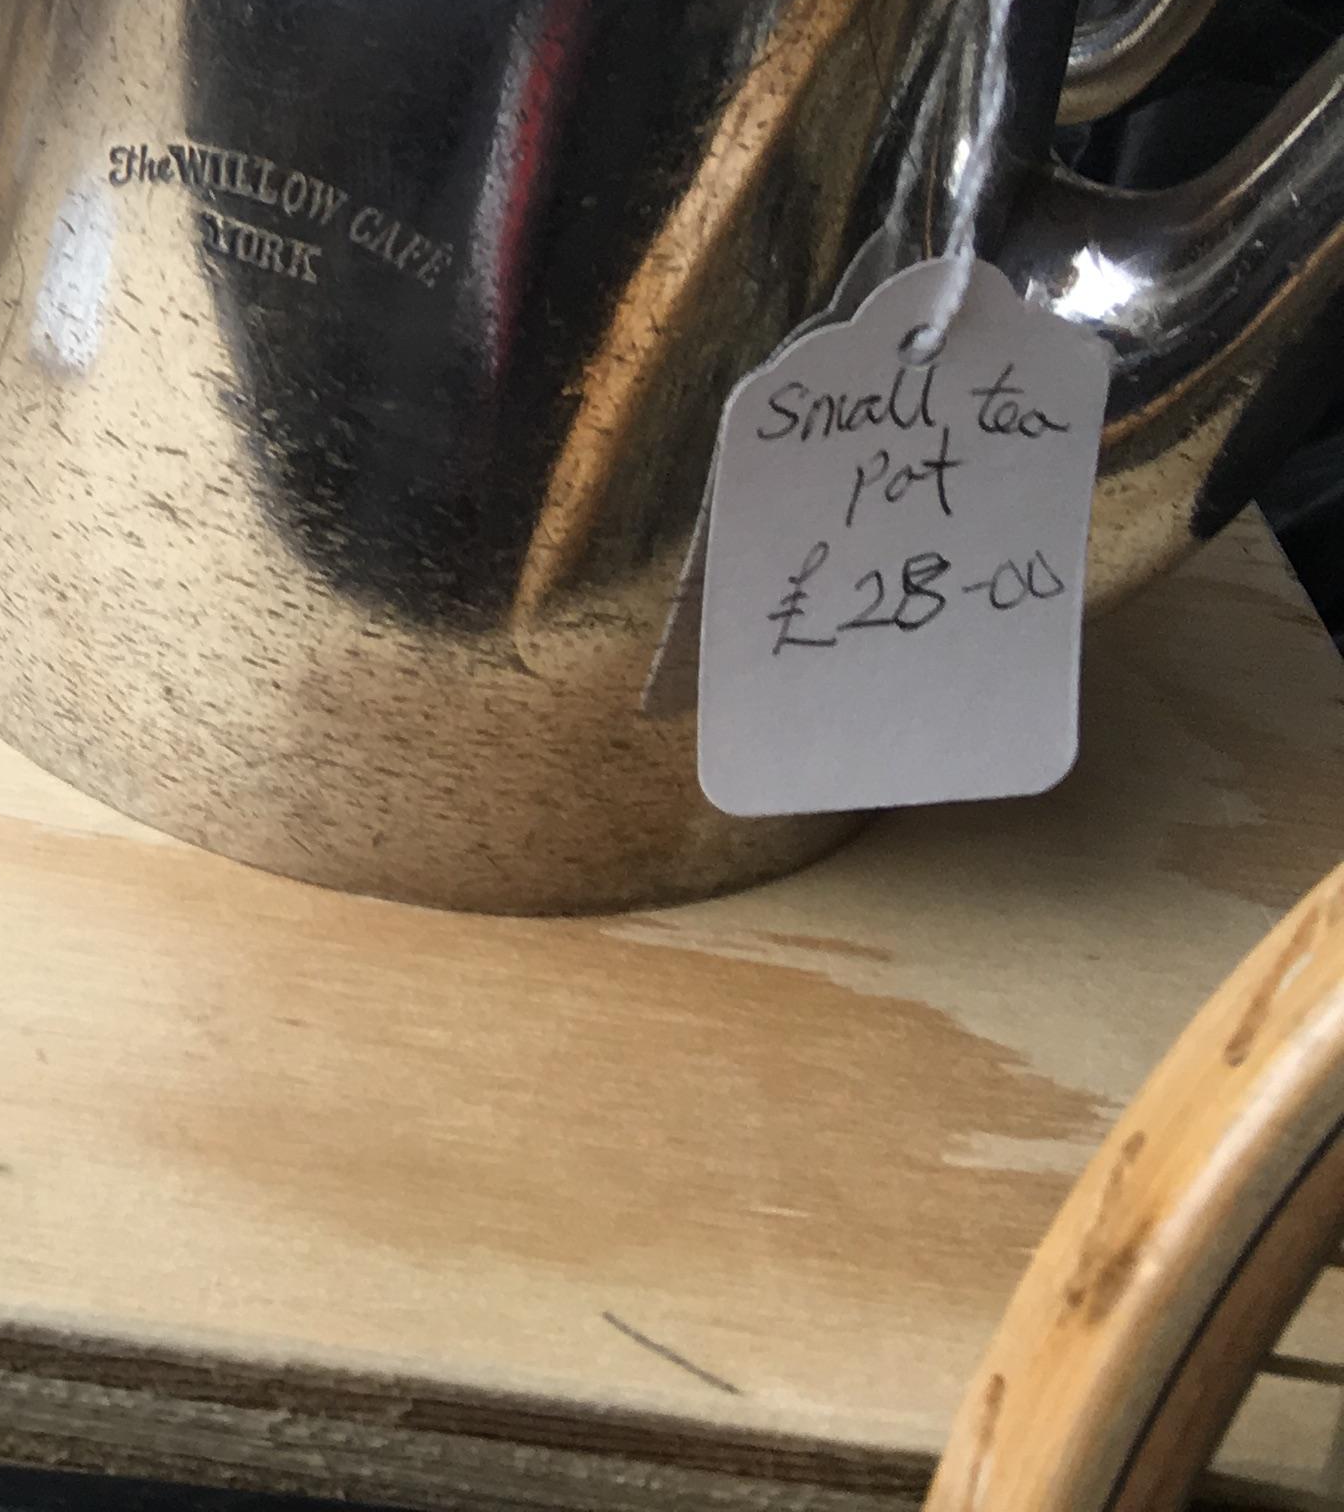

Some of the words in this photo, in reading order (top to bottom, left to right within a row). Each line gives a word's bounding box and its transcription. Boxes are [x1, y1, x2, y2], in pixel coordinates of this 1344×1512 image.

[108, 143, 174, 187] The
[167, 143, 350, 226] WILLOW
[201, 208, 323, 285] YORK
[756, 367, 936, 442] Small
[972, 363, 1071, 439] tea
